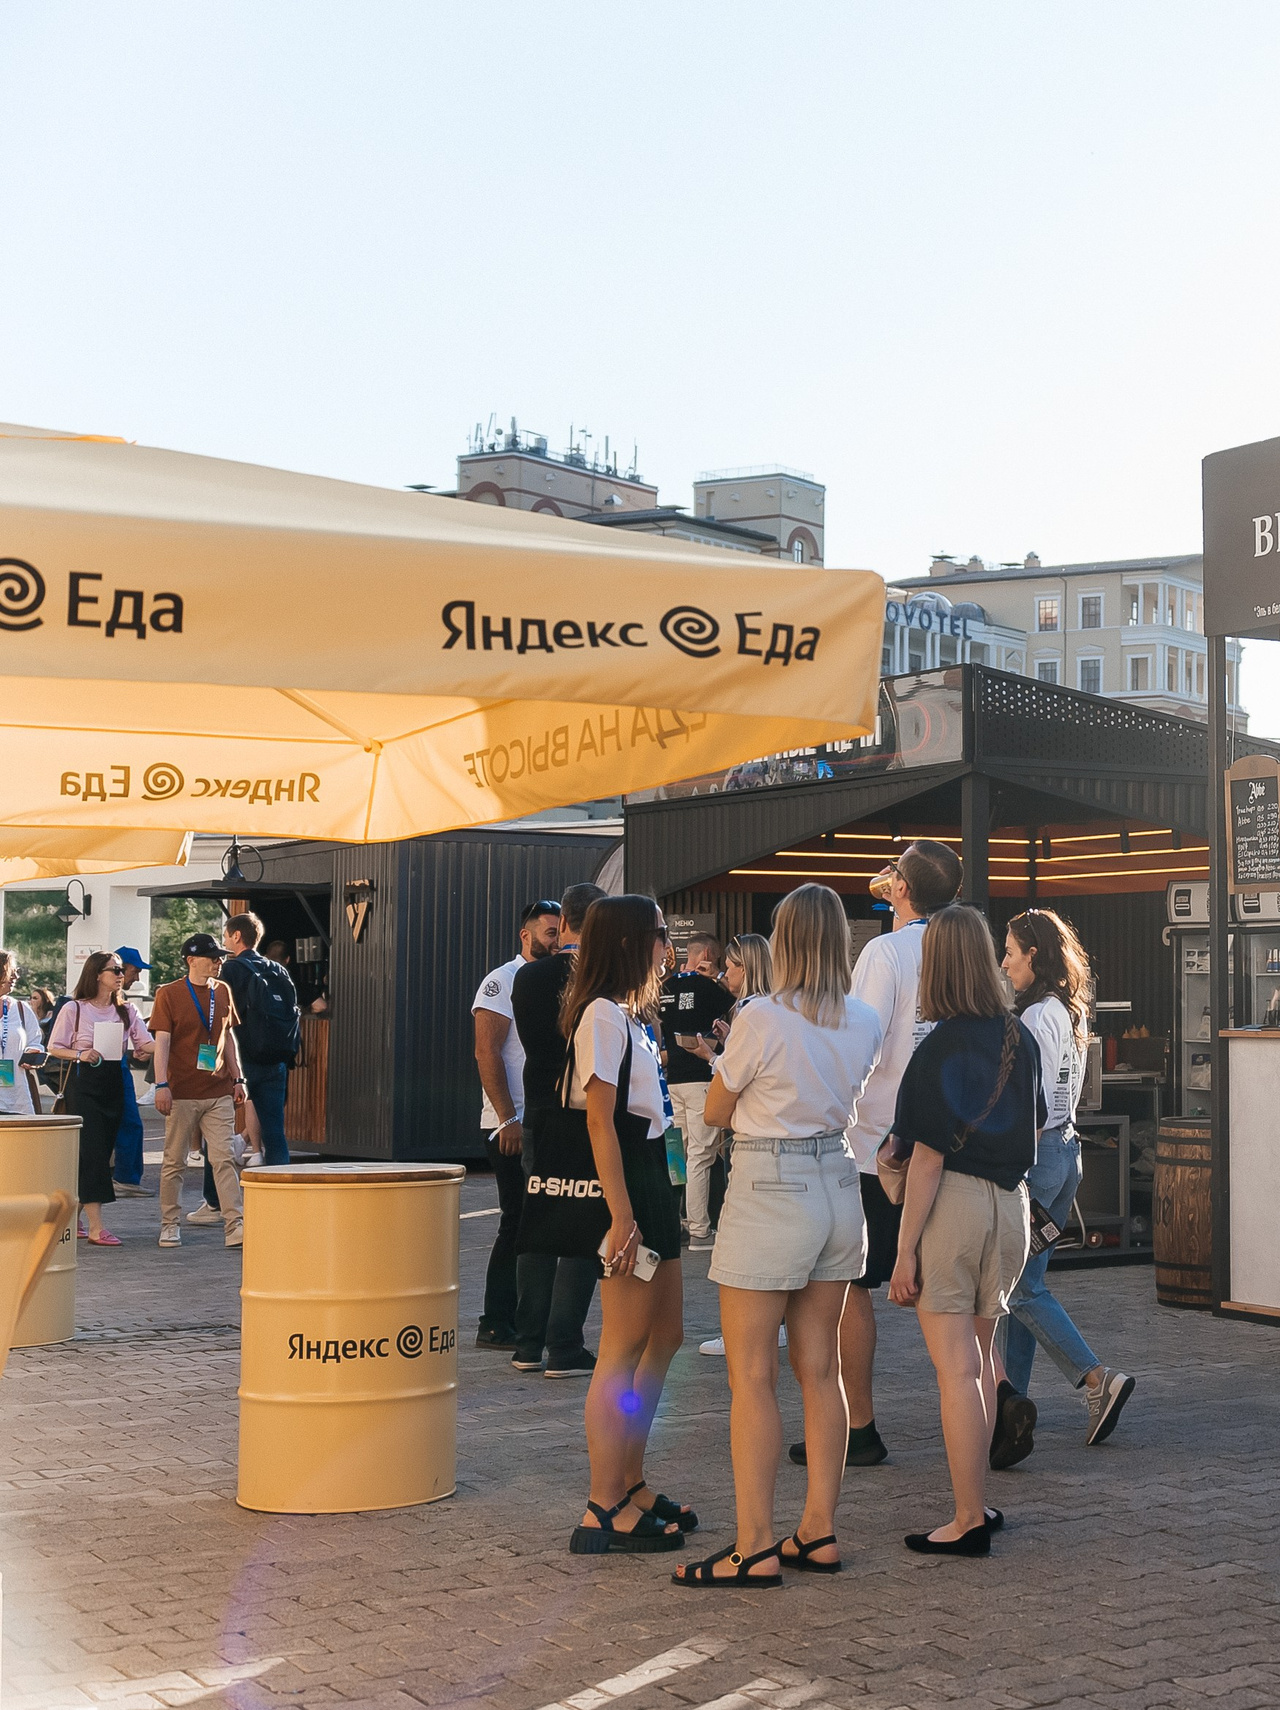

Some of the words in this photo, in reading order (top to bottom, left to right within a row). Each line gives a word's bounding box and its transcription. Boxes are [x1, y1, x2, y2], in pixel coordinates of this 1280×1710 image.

[67, 571, 184, 640] Еда
[886, 601, 972, 640] OVOTEL
[441, 600, 648, 654] Яндекс
[735, 611, 820, 666] Еда
[674, 919, 695, 928] МЕНЮ
[527, 1175, 607, 1198] G-SHOC
[288, 1333, 390, 1364] Яндекс
[429, 1325, 455, 1354] Еда
